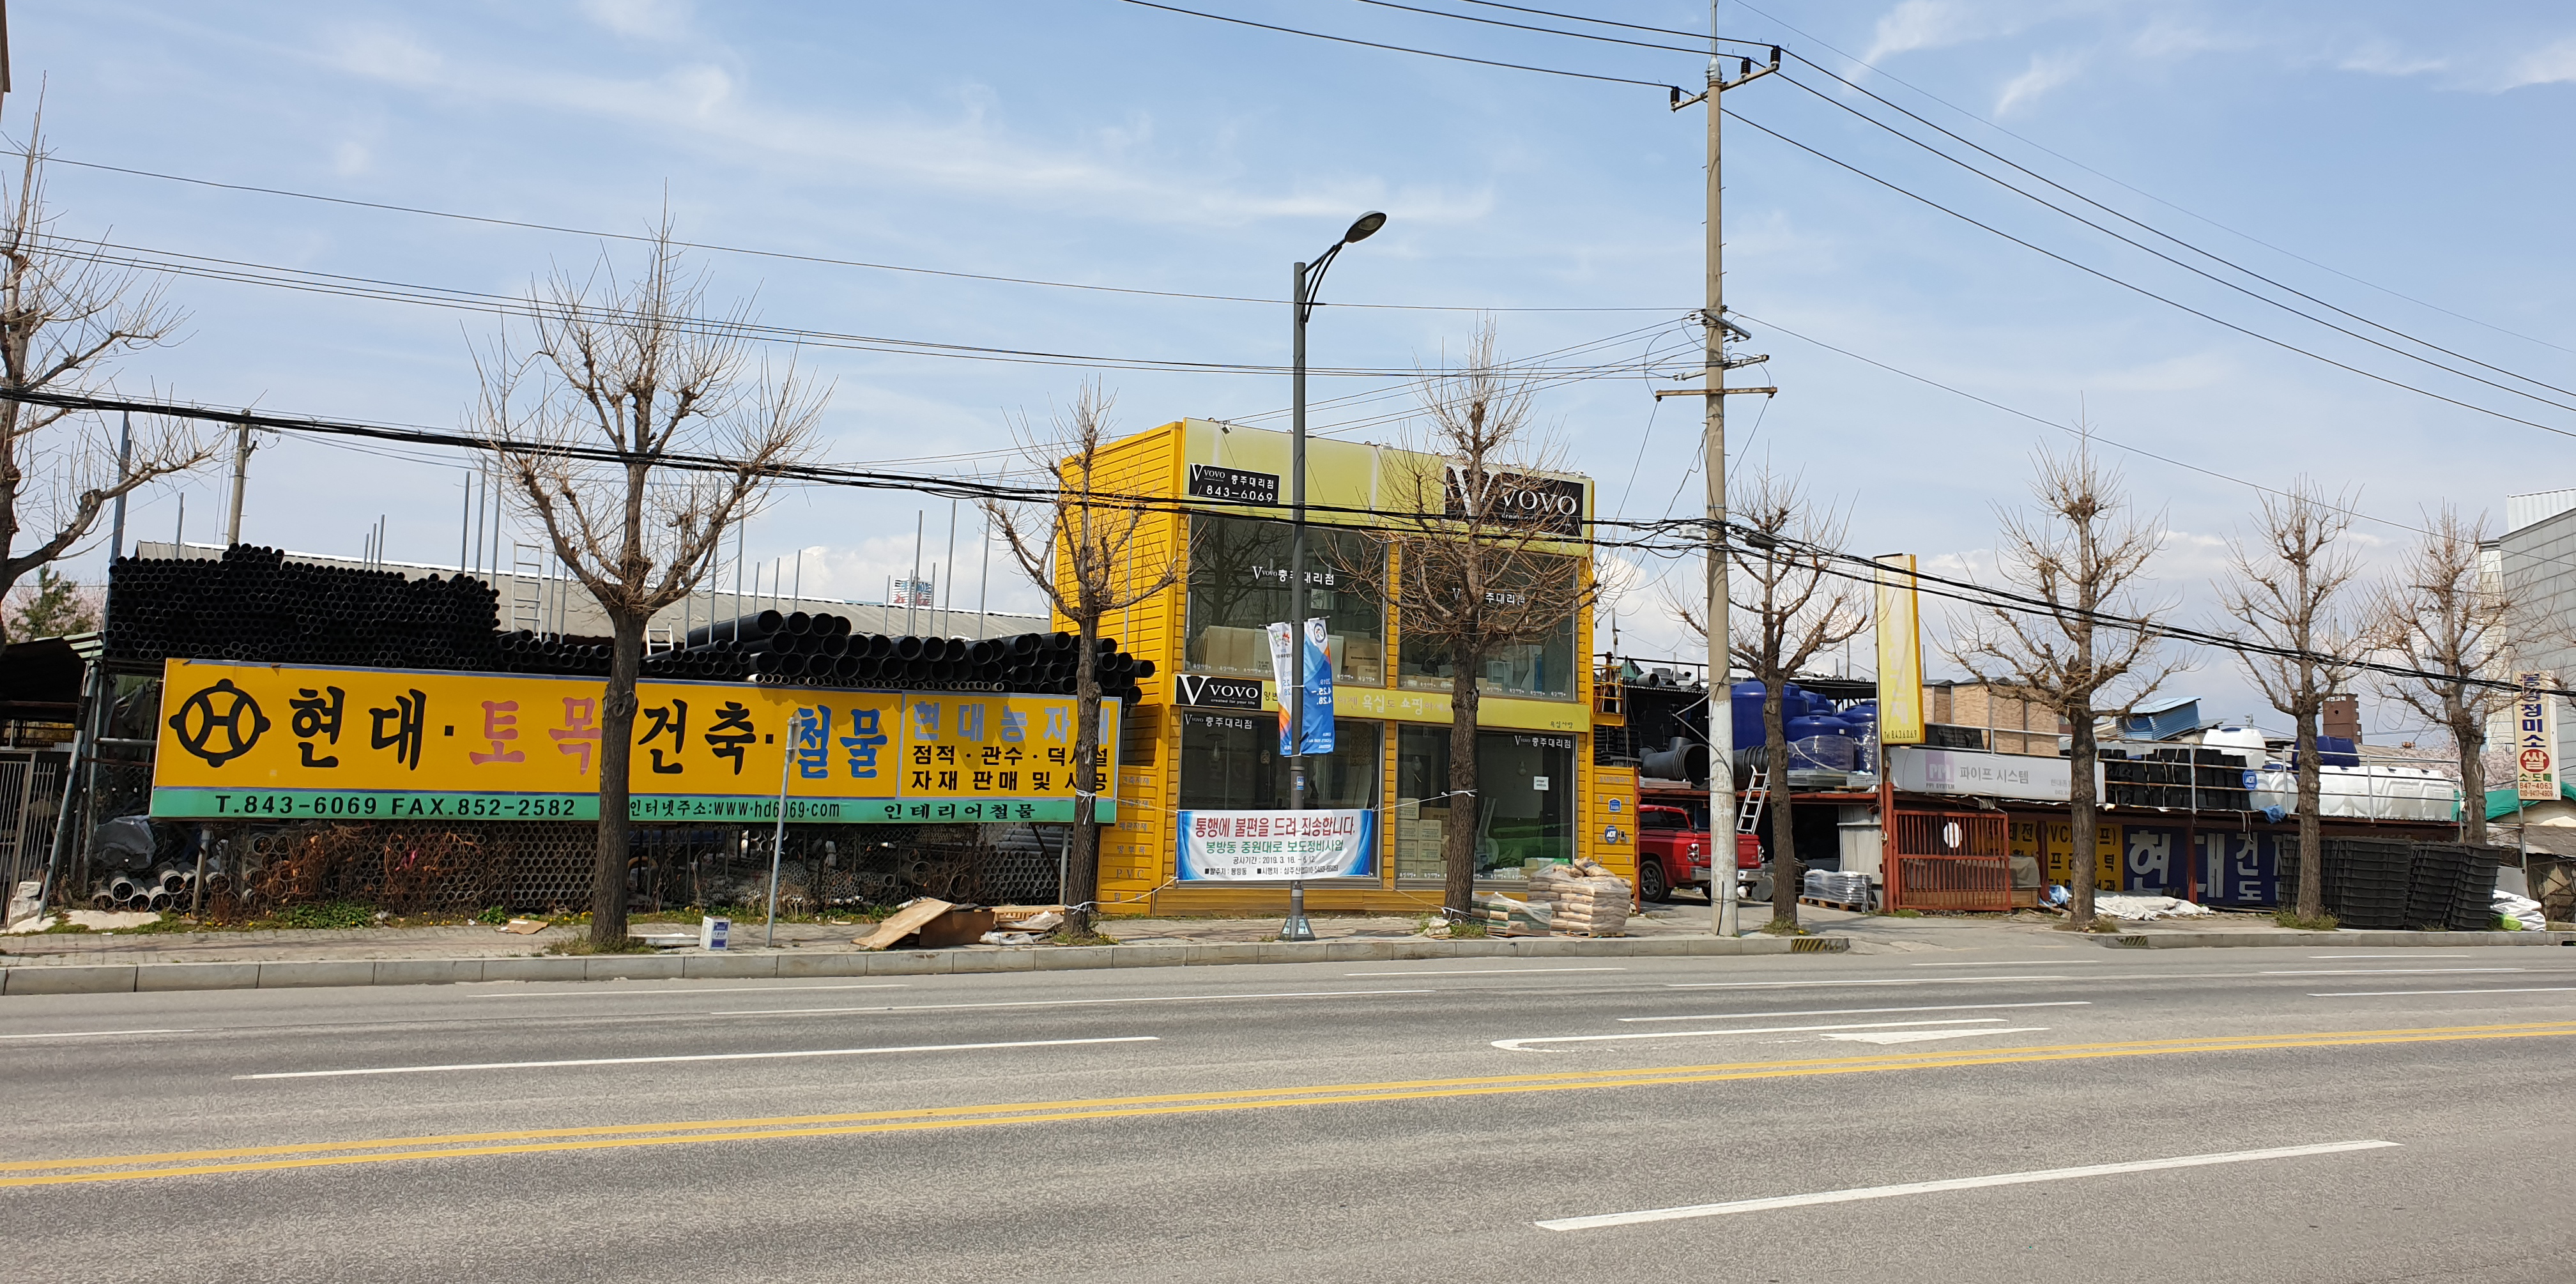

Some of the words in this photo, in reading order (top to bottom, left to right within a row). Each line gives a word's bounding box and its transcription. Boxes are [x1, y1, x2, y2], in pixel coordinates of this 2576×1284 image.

[1231, 475, 1274, 490] 충주대리점
[1206, 485, 1273, 503] 843-6069
[1209, 685, 1259, 698] VOVO
[1206, 716, 1252, 730] 충주대리점
[1532, 737, 1571, 749] 충주대리점
[913, 745, 955, 765] 점적
[981, 747, 1023, 766] 관수
[2523, 751, 2547, 770] 쌀
[912, 770, 958, 791] 자재
[972, 771, 1018, 791] 판매
[1032, 772, 1051, 791] 및
[1959, 766, 1994, 781] 파이프
[1997, 769, 2029, 785] 시스템
[215, 795, 377, 814] T.843-6069
[391, 798, 574, 816] FAX.852-2582
[1195, 818, 1230, 837] 통행에
[1235, 818, 1269, 837] 불편을
[1273, 817, 1296, 837] 드려
[1301, 816, 1355, 837] 죄송합니다.
[1206, 841, 1237, 854] 봉방동
[1241, 841, 1283, 854] 중원대로
[1287, 840, 1344, 853] 보도정비사업
[1116, 869, 1144, 879] PVC
